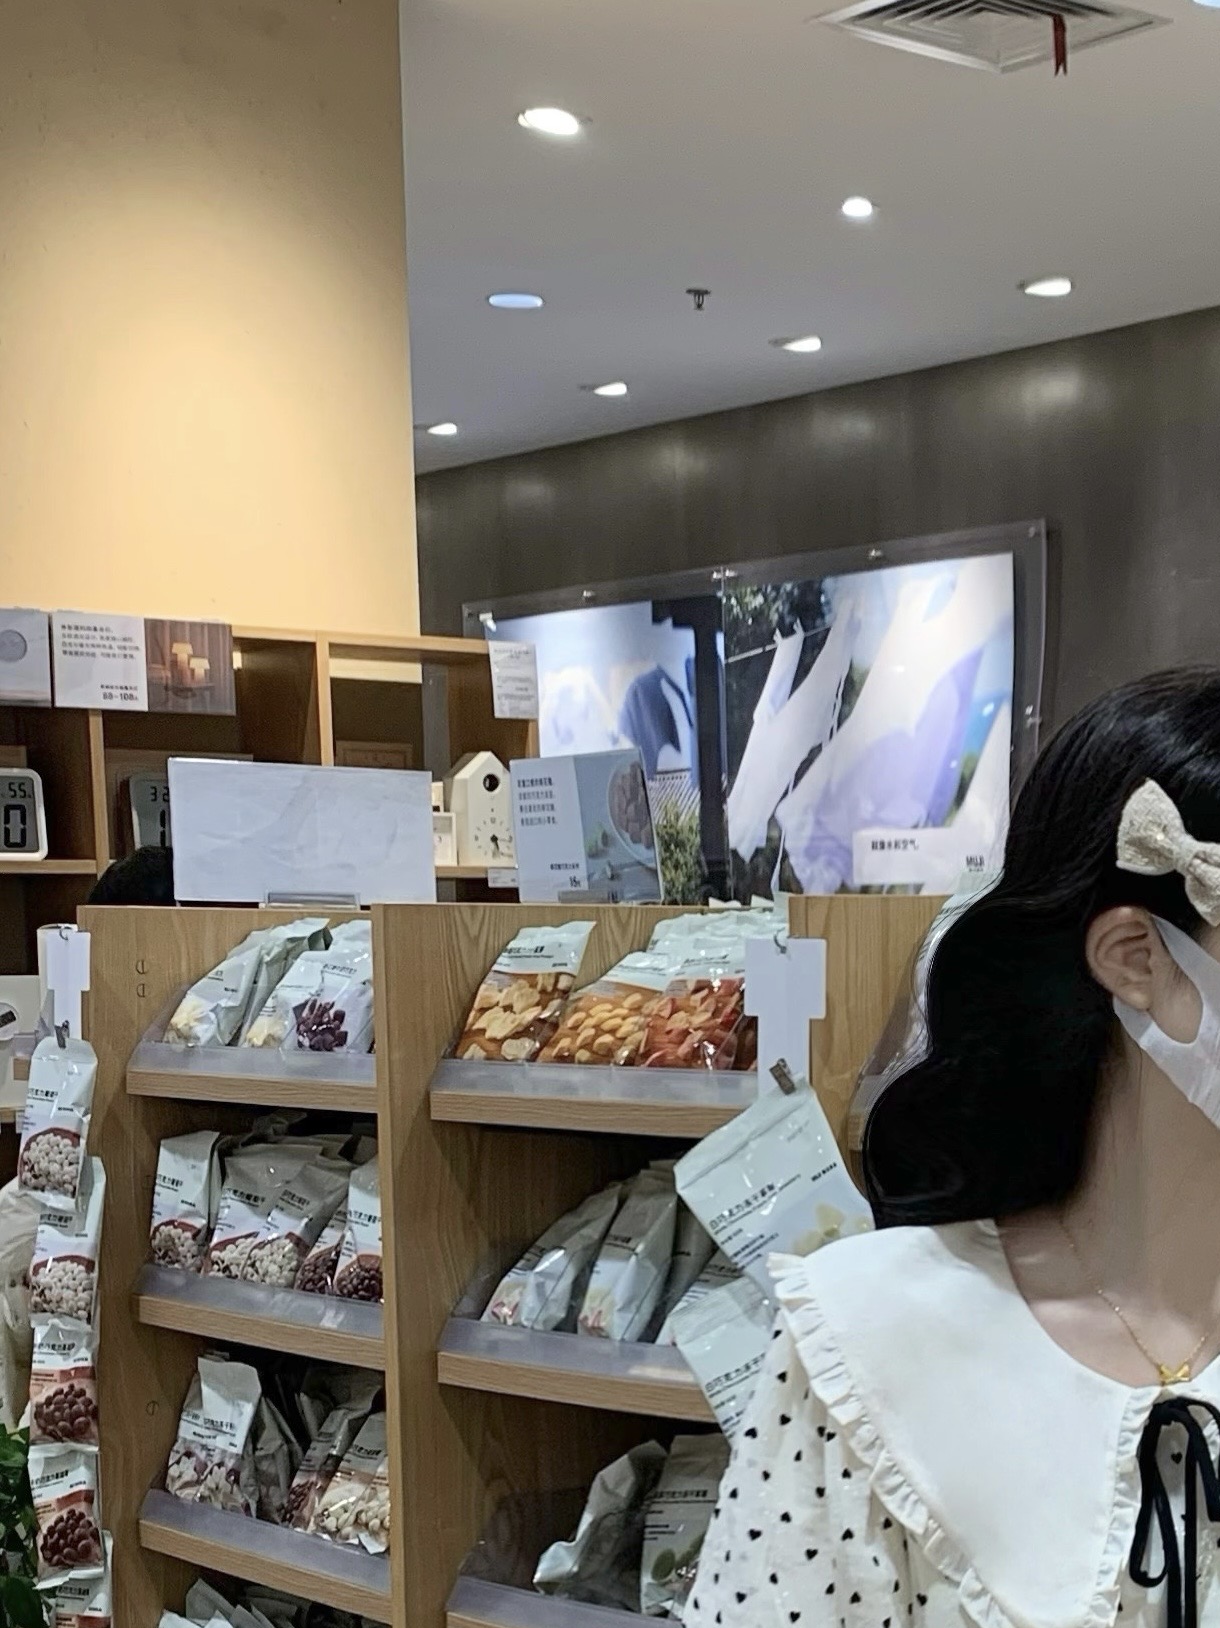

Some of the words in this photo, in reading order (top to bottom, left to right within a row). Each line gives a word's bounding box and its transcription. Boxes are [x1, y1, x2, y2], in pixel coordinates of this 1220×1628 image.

[8, 781, 27, 799] 55
[4, 804, 27, 849] 0
[966, 855, 985, 868] MUJI
